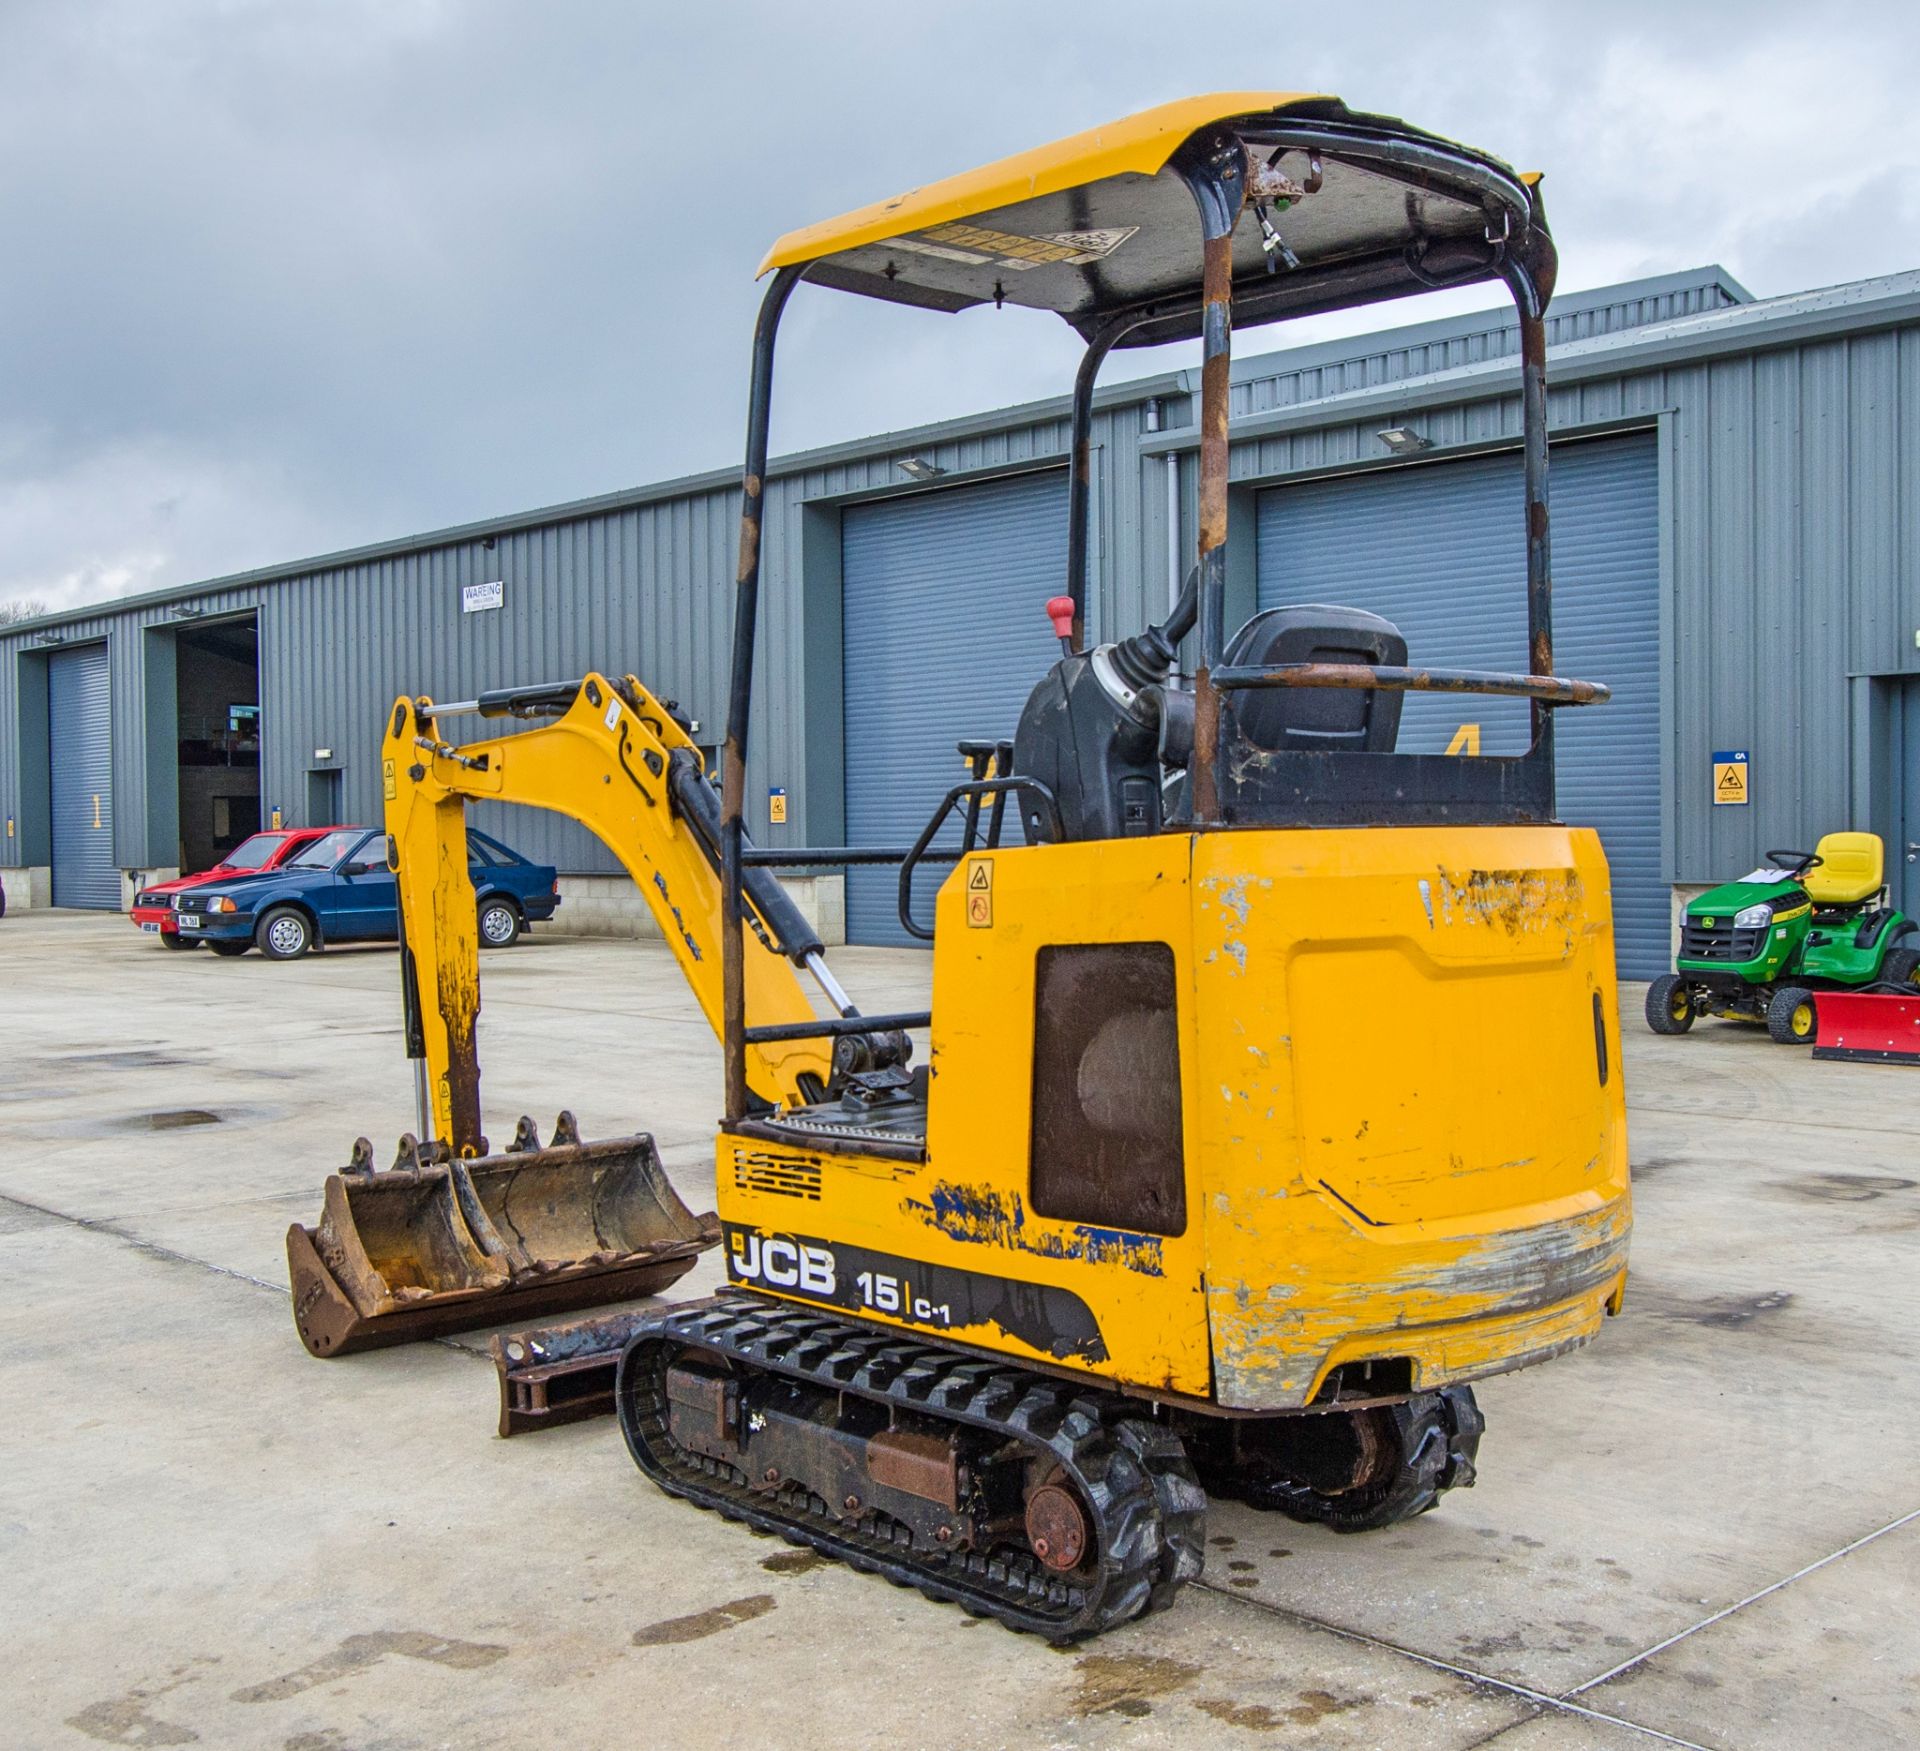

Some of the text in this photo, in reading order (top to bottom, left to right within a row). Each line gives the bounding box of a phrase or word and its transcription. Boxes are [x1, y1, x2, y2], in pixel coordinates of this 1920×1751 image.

[465, 583, 501, 599] WAREING
[733, 1235, 836, 1295] JCB
[857, 1271, 899, 1311] 15
